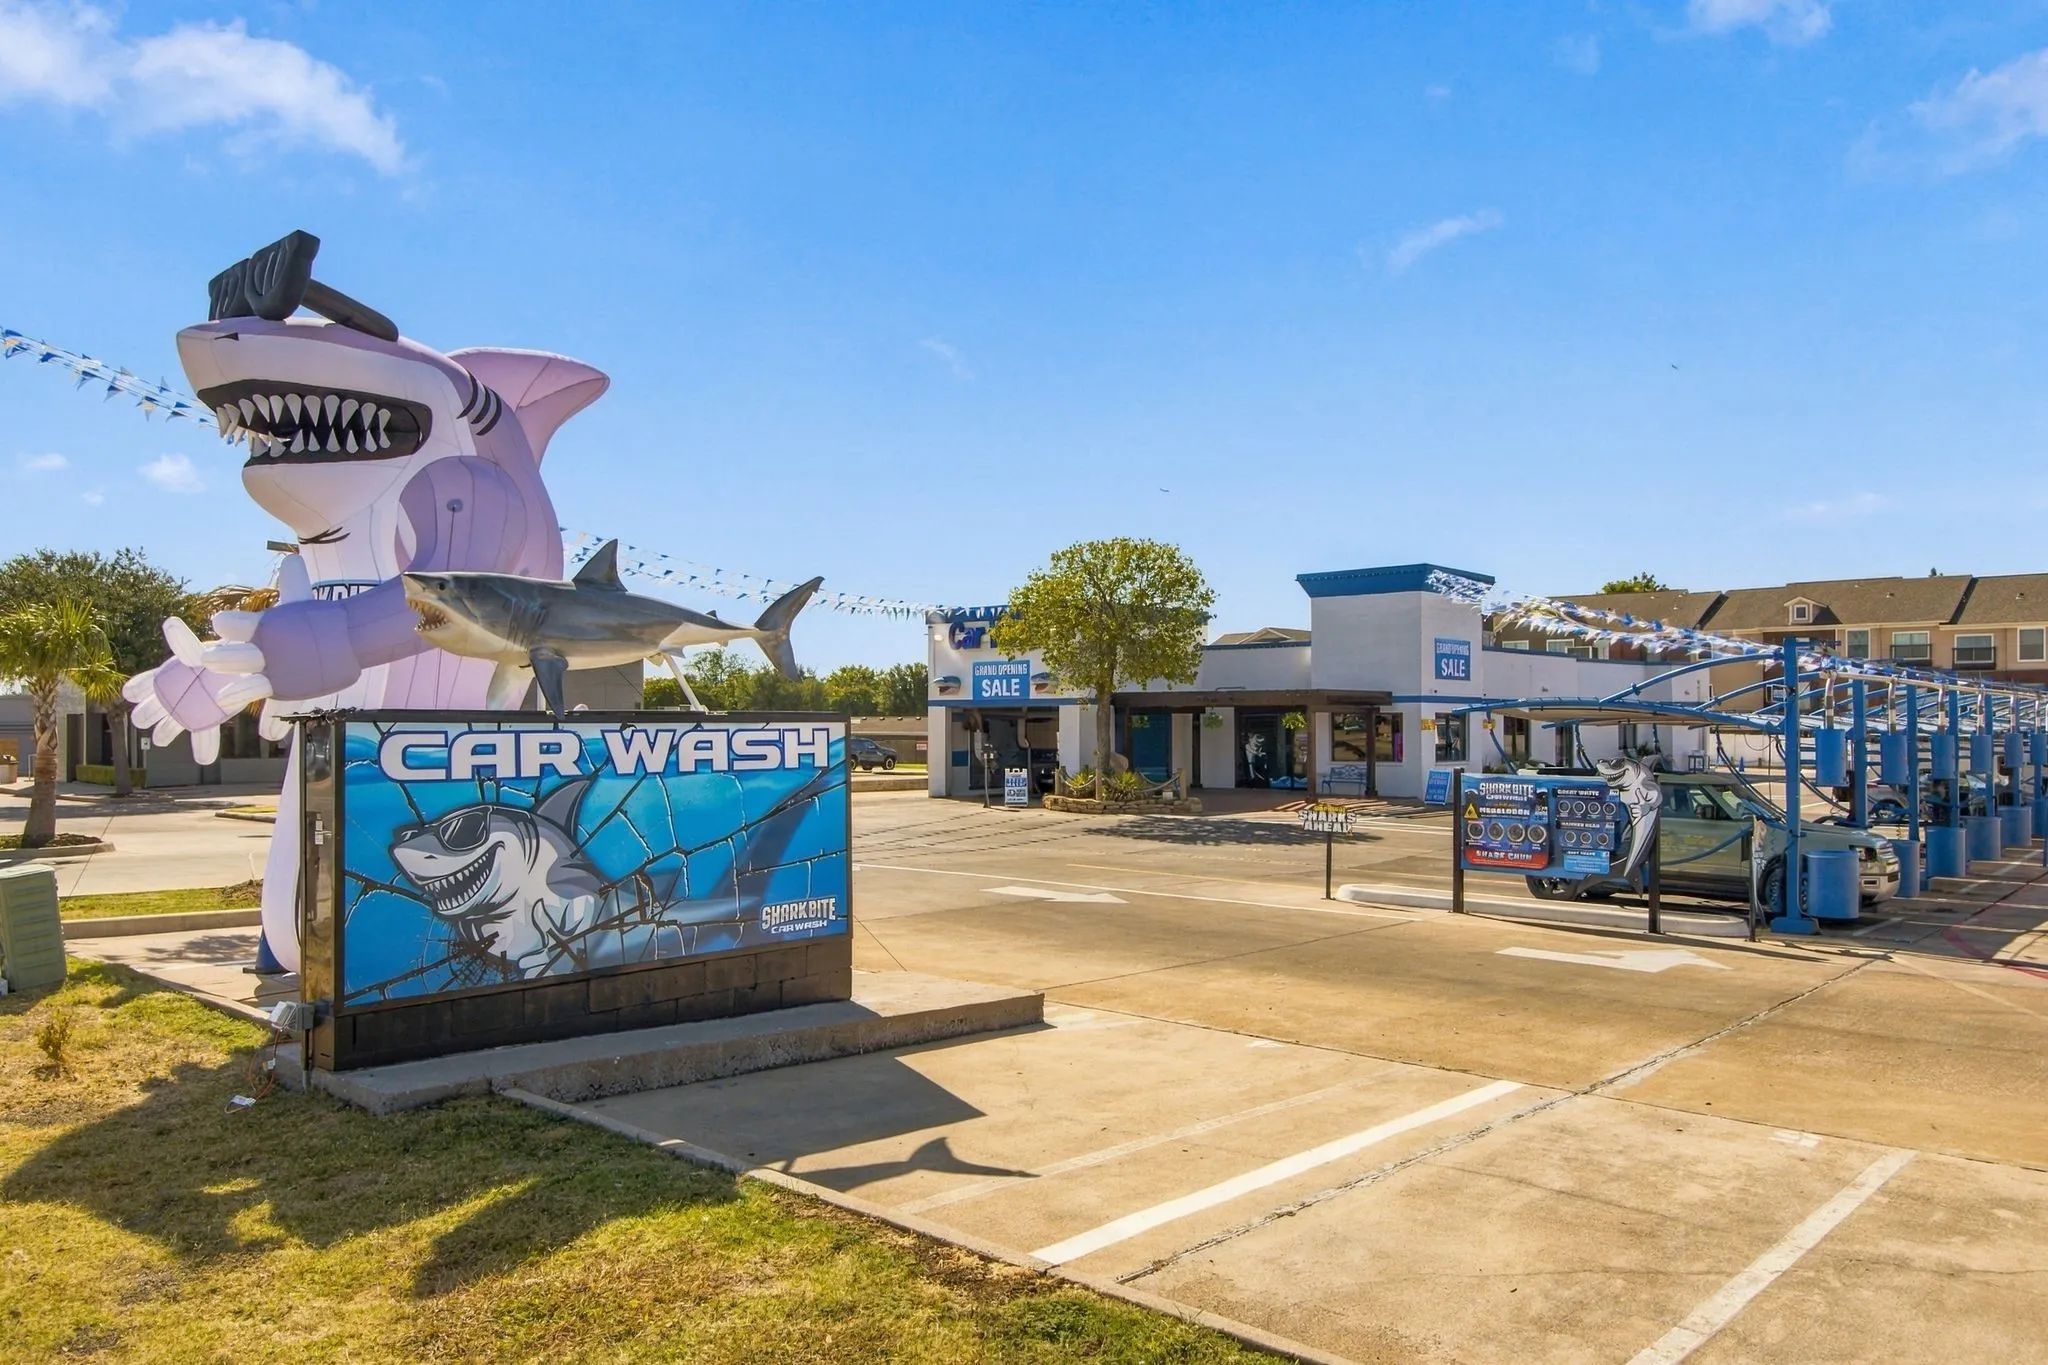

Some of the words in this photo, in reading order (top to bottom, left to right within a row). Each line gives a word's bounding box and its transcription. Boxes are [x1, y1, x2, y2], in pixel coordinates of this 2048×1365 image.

[948, 620, 986, 650] Car
[974, 664, 997, 676] GRAND
[998, 663, 1028, 675] OPENING
[1441, 658, 1466, 677] SALE
[981, 678, 1021, 698] SALE
[380, 729, 585, 782] CAR
[601, 726, 830, 776] WASH
[1298, 810, 1357, 823] SHARKS
[1303, 820, 1352, 833] AHEAD
[761, 897, 836, 930] SHARKBITE
[771, 924, 794, 934] CAR
[795, 920, 828, 931] WASH
